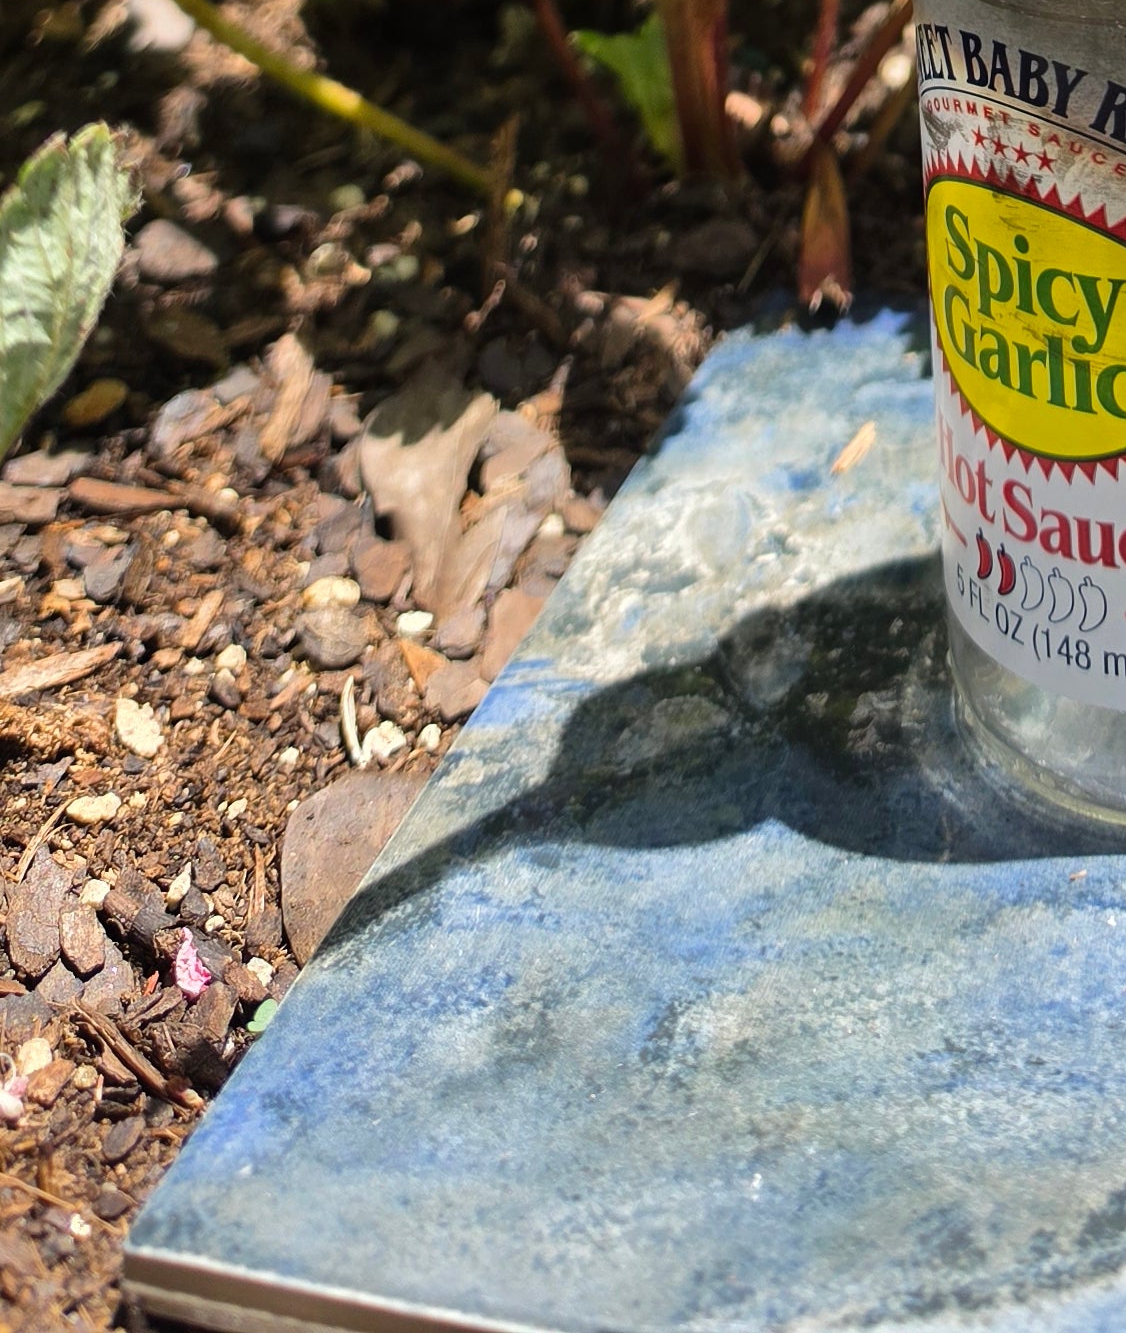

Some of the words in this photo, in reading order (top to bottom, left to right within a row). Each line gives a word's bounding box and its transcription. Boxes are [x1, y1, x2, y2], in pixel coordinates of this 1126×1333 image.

[926, 97, 1010, 126] GOURMET
[960, 30, 1088, 119] BABY
[944, 204, 1126, 354] Spicy
[938, 405, 996, 525] Hot
[969, 578, 990, 623] FL
[995, 602, 1025, 645] OZ
[1033, 623, 1092, 670] (148
